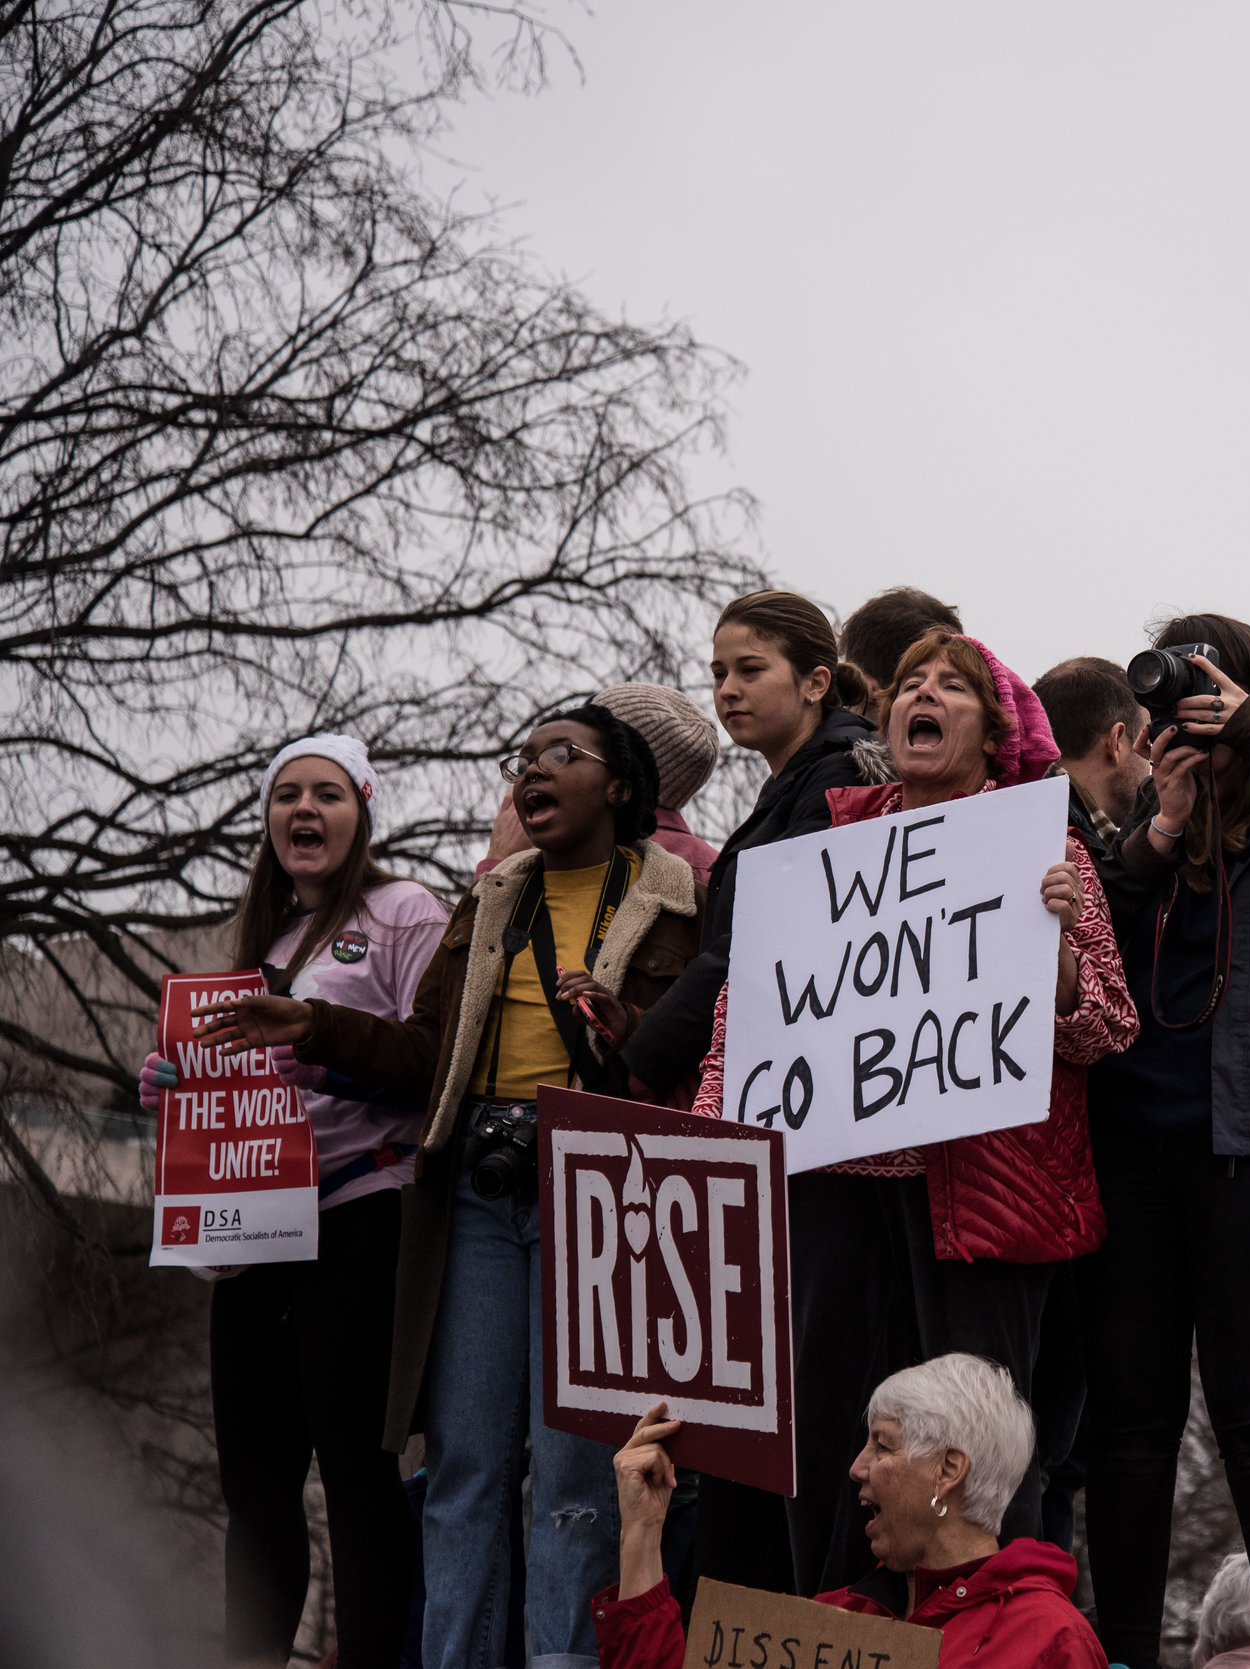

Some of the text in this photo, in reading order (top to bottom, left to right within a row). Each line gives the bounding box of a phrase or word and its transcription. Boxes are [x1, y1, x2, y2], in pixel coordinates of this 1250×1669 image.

[821, 815, 946, 923] WE
[597, 905, 616, 940] Nikon
[775, 894, 1004, 1025] WON'T
[738, 996, 1030, 1131] GO BACK
[175, 1091, 226, 1130] THE
[209, 1138, 281, 1180] UNITE!
[205, 1229, 303, 1242] Democratic Socialists of America
